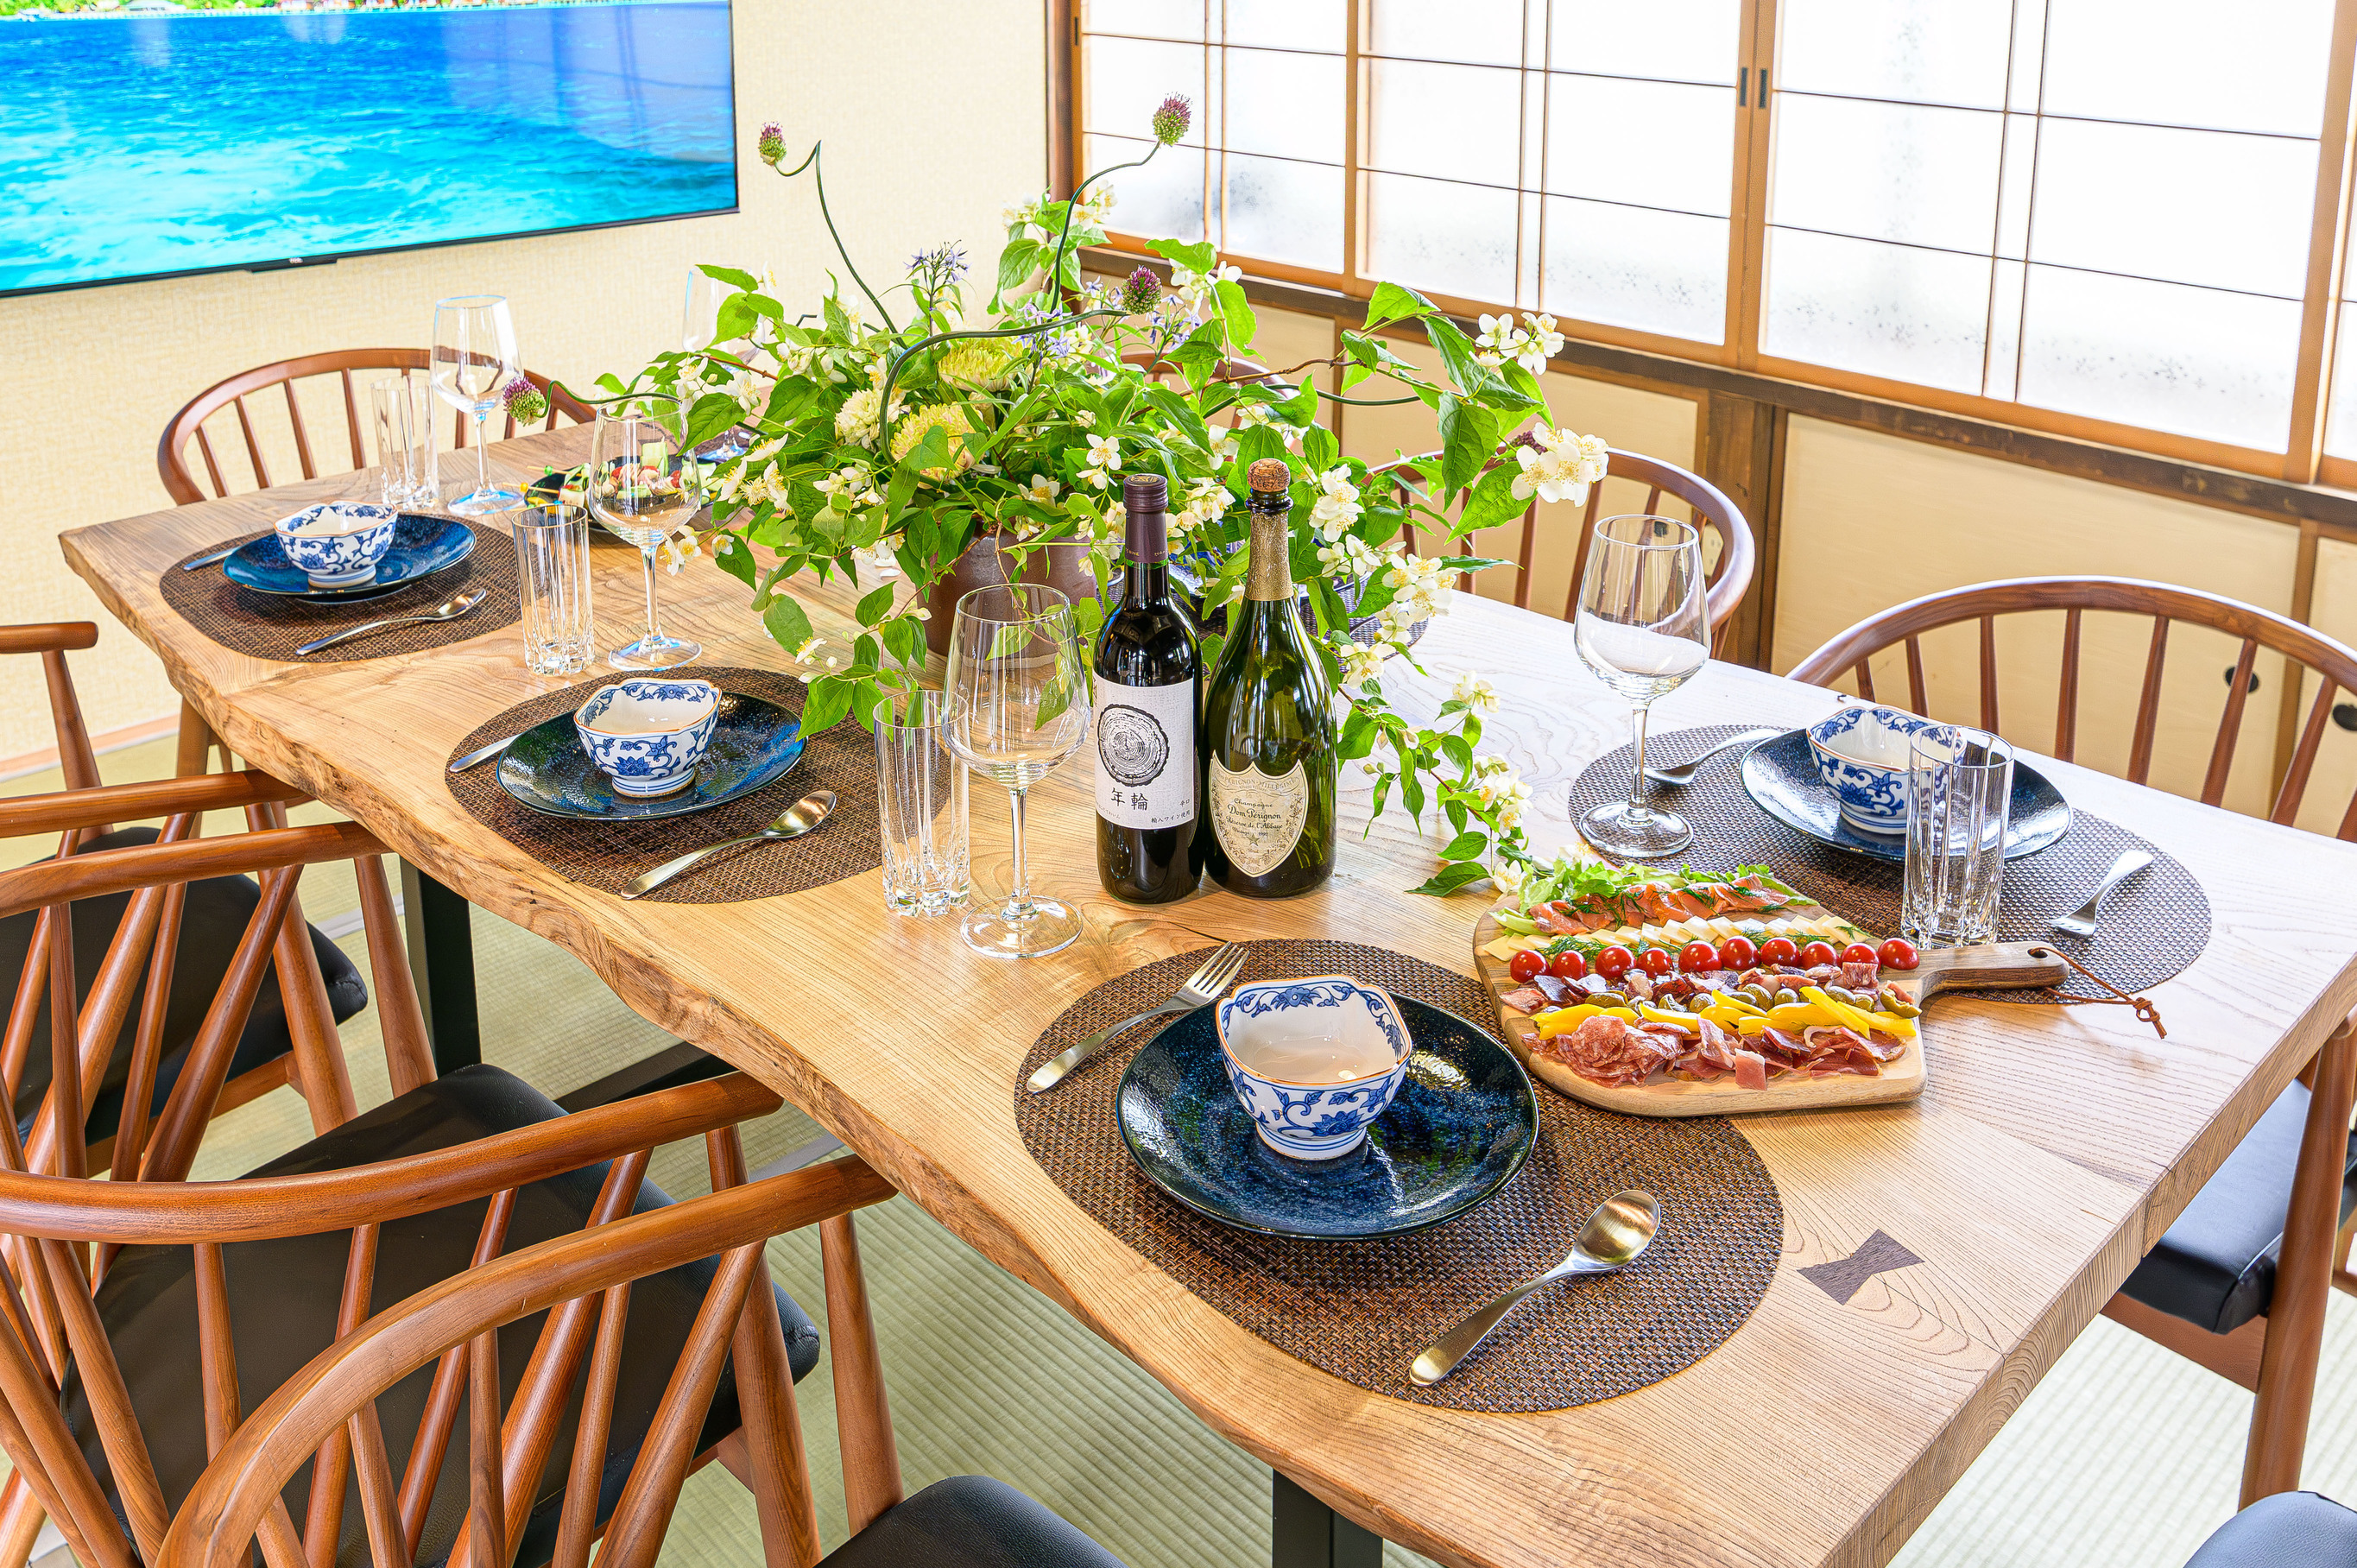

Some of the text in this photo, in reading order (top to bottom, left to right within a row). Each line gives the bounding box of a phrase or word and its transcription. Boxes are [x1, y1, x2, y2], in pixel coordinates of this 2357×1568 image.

[1110, 787, 1149, 811] 年輪
[1234, 797, 1273, 809] Champagne
[1228, 804, 1281, 822] Dom Pérignon
